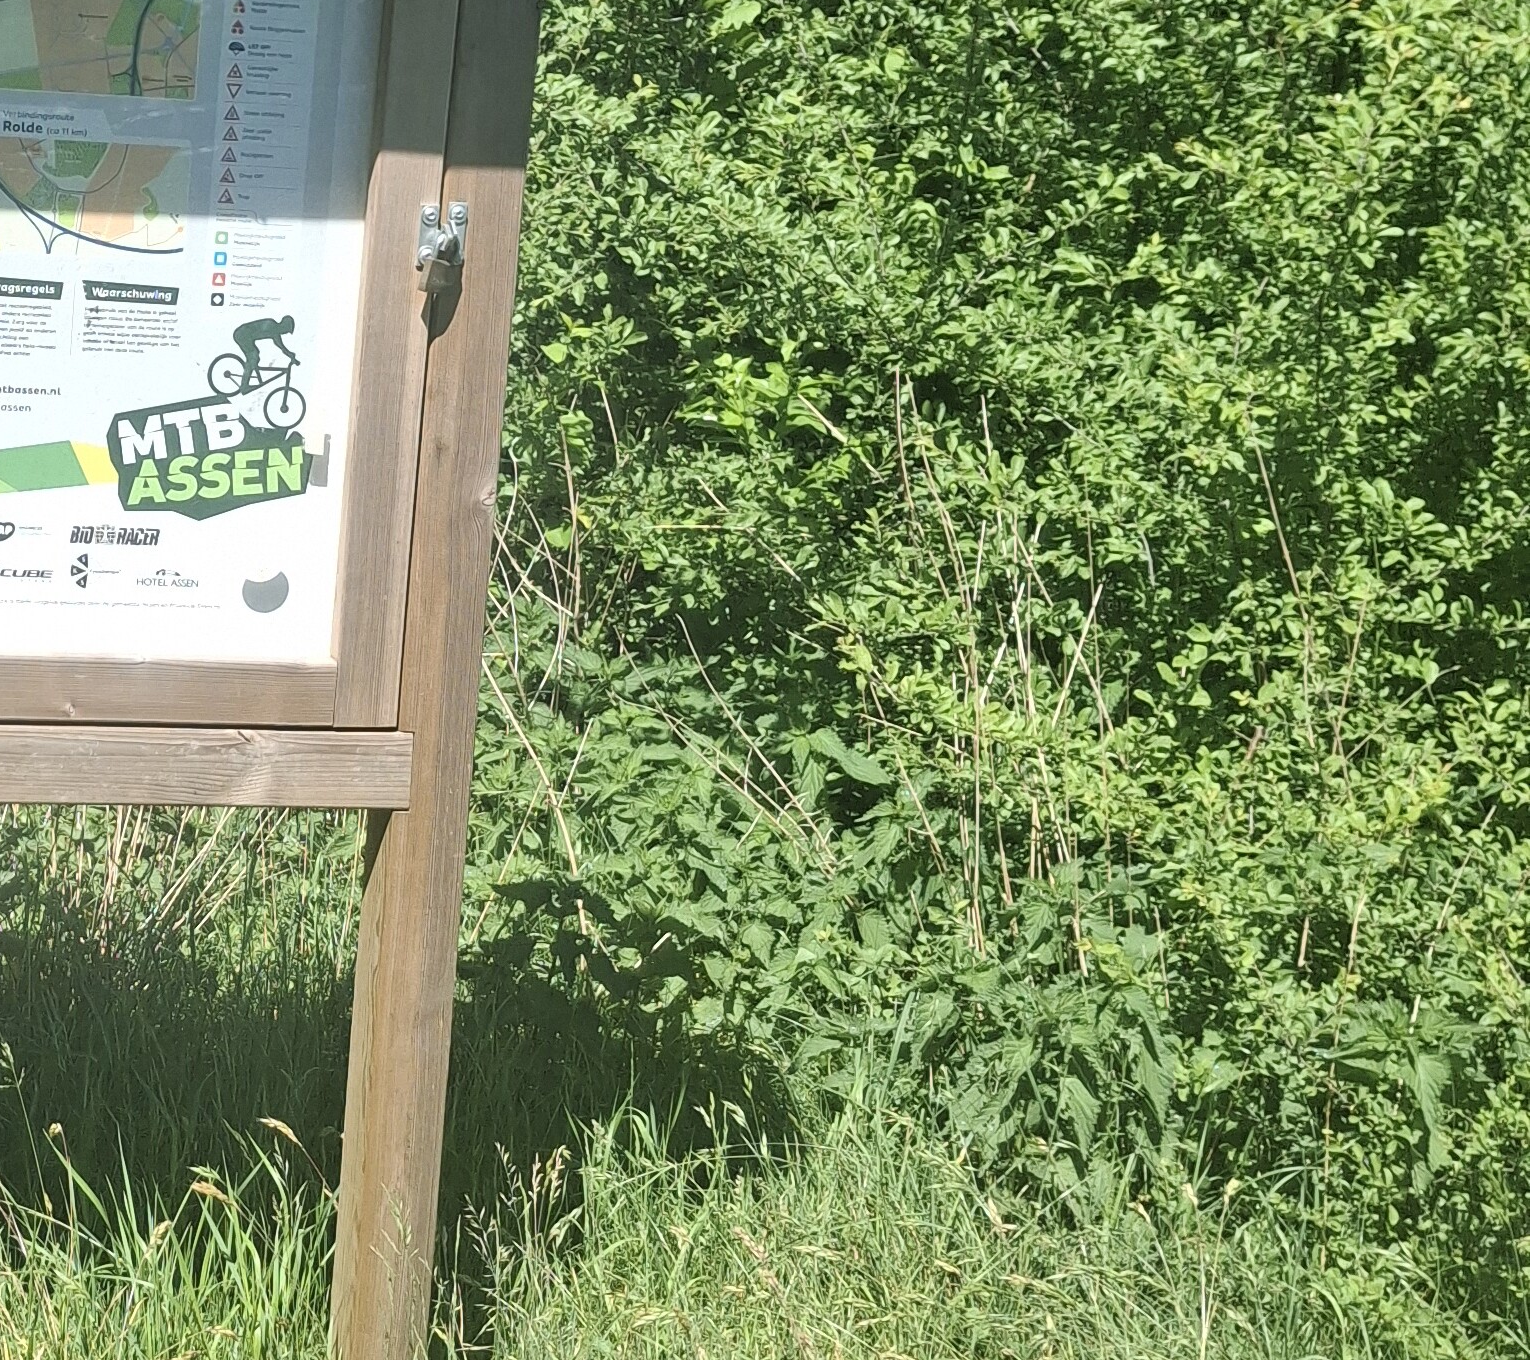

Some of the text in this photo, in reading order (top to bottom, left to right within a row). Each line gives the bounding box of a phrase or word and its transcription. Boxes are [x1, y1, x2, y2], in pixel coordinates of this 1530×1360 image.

[2, 109, 75, 122] Verbindingsroute
[2, 120, 43, 134] Rolde
[91, 286, 173, 302] Waarschuwing
[117, 402, 246, 465] MTB
[127, 445, 304, 506] ASSEN
[0, 568, 55, 579] CUBE
[136, 577, 199, 588] HOTEL ASSEN
